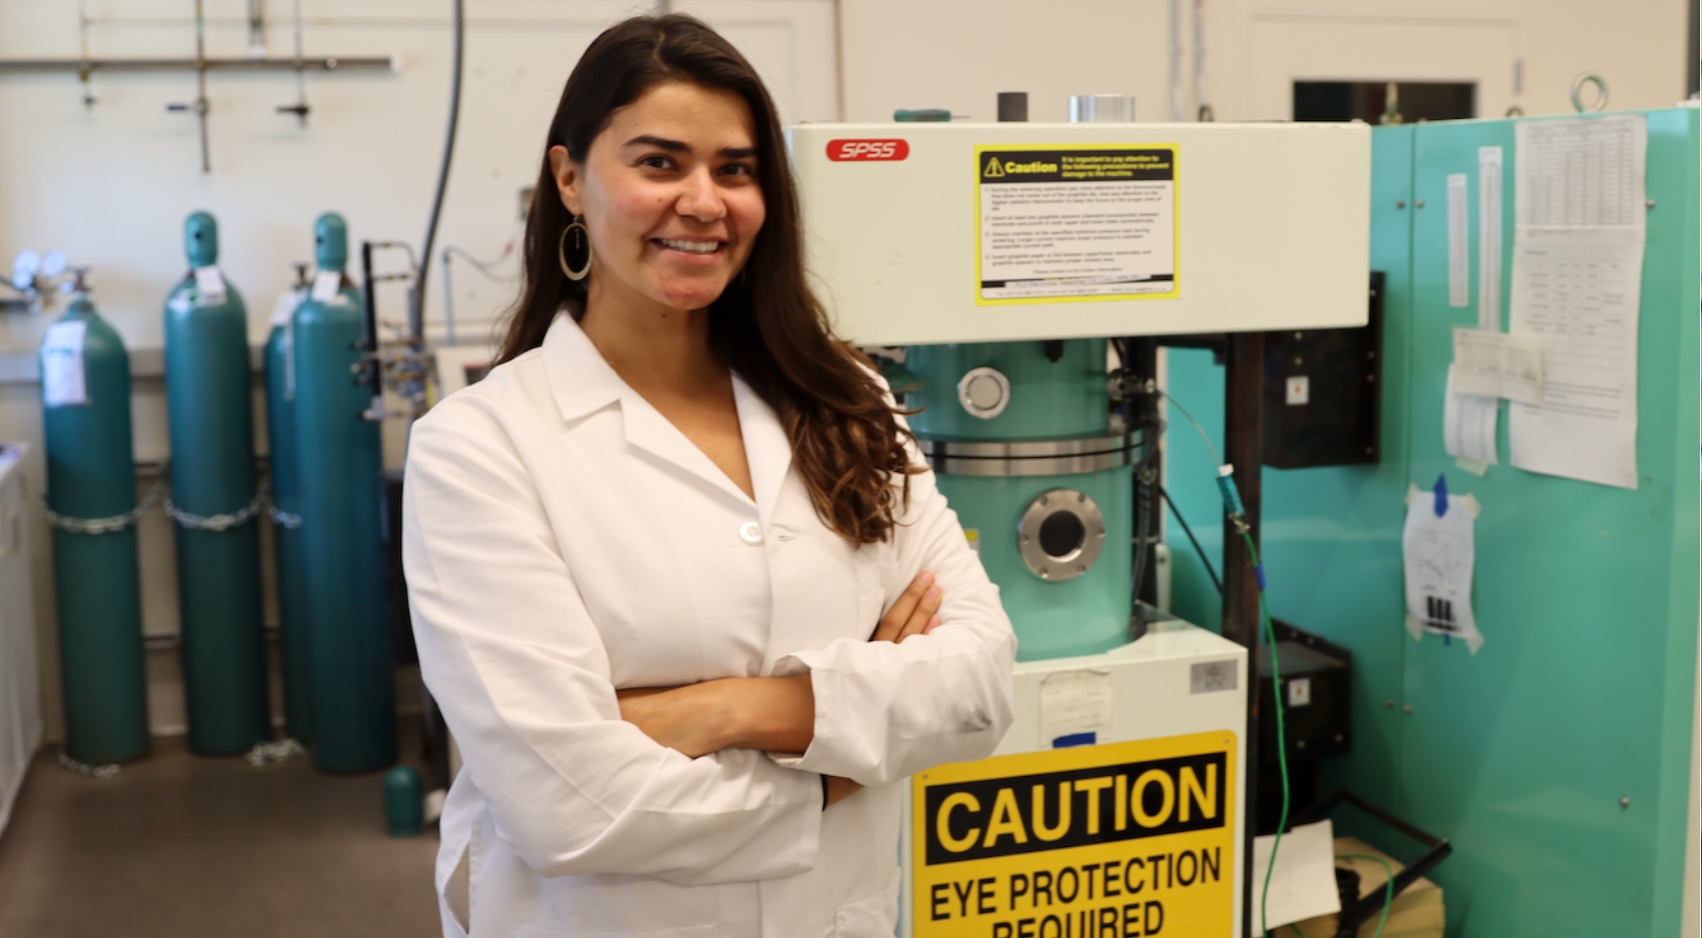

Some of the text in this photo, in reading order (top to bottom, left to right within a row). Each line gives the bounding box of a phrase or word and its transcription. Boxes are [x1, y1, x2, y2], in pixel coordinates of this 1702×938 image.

[839, 142, 897, 158] SPSS
[1005, 161, 1058, 174] Caution
[936, 763, 1217, 853] CAUTION
[930, 846, 1221, 921] EYE PROTECTION
